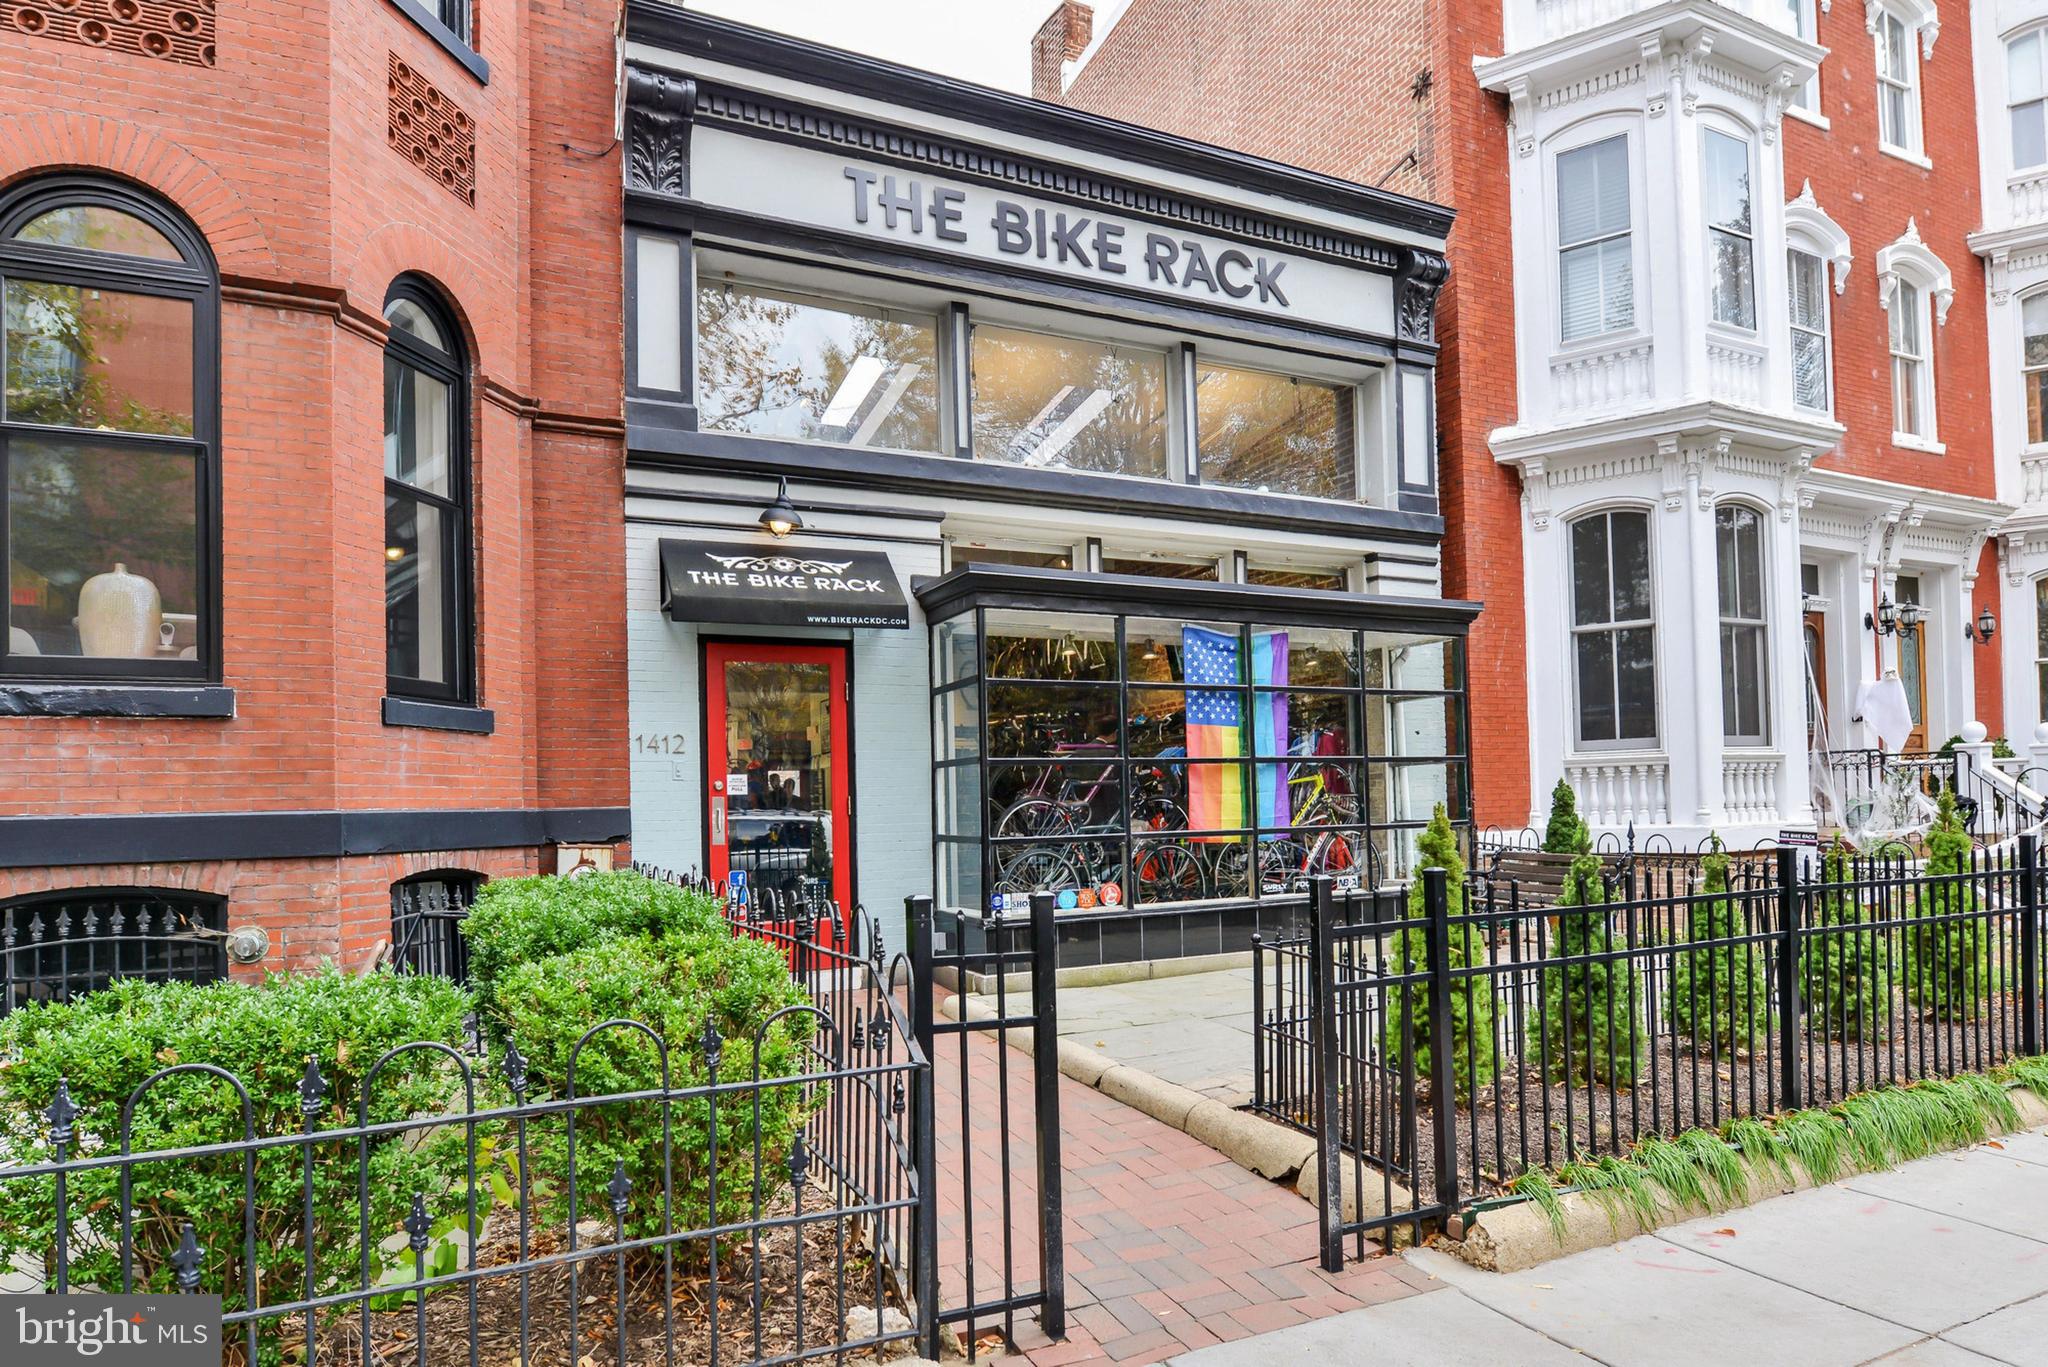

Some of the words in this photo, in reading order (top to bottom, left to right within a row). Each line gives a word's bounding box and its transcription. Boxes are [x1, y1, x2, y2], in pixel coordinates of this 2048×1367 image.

[843, 166, 967, 242] THE
[992, 200, 1127, 273] BIKE
[1144, 232, 1289, 306] RACK
[687, 570, 739, 586] THE
[747, 575, 807, 589] BIKE
[814, 578, 885, 593] RACK
[807, 616, 907, 625] WWW.BIKERACKDC.COM
[635, 734, 685, 754] 1412
